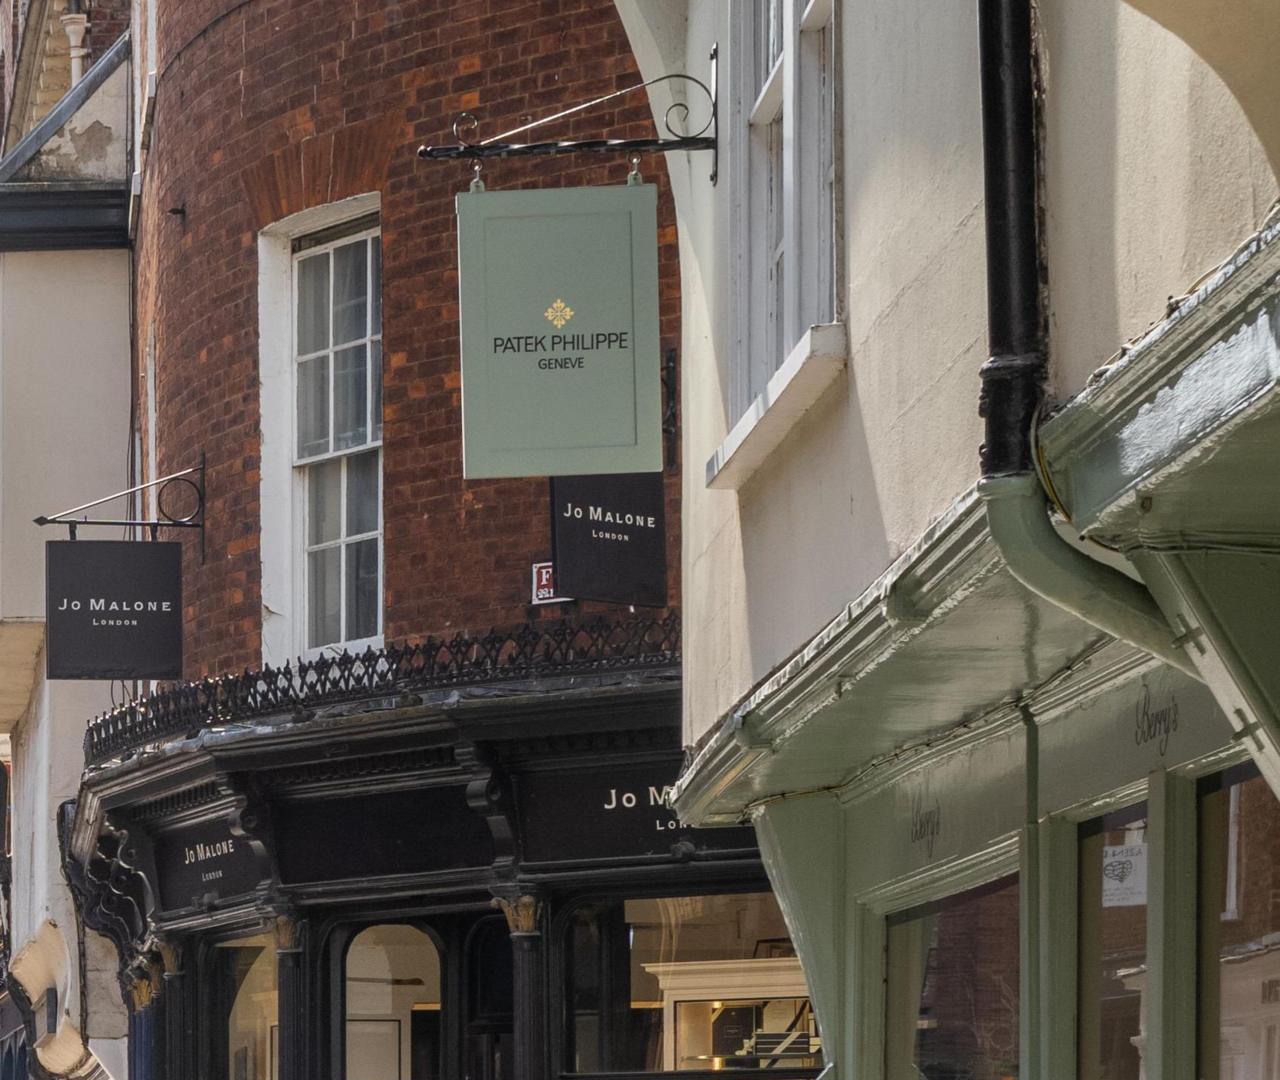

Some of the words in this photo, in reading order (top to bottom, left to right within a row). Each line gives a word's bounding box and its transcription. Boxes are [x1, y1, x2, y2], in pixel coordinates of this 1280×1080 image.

[493, 335, 547, 353] PATEK
[551, 332, 629, 351] PHILIPPE
[538, 357, 584, 370] GENEVE
[589, 506, 656, 528] MALONE
[90, 598, 171, 611] MALONE
